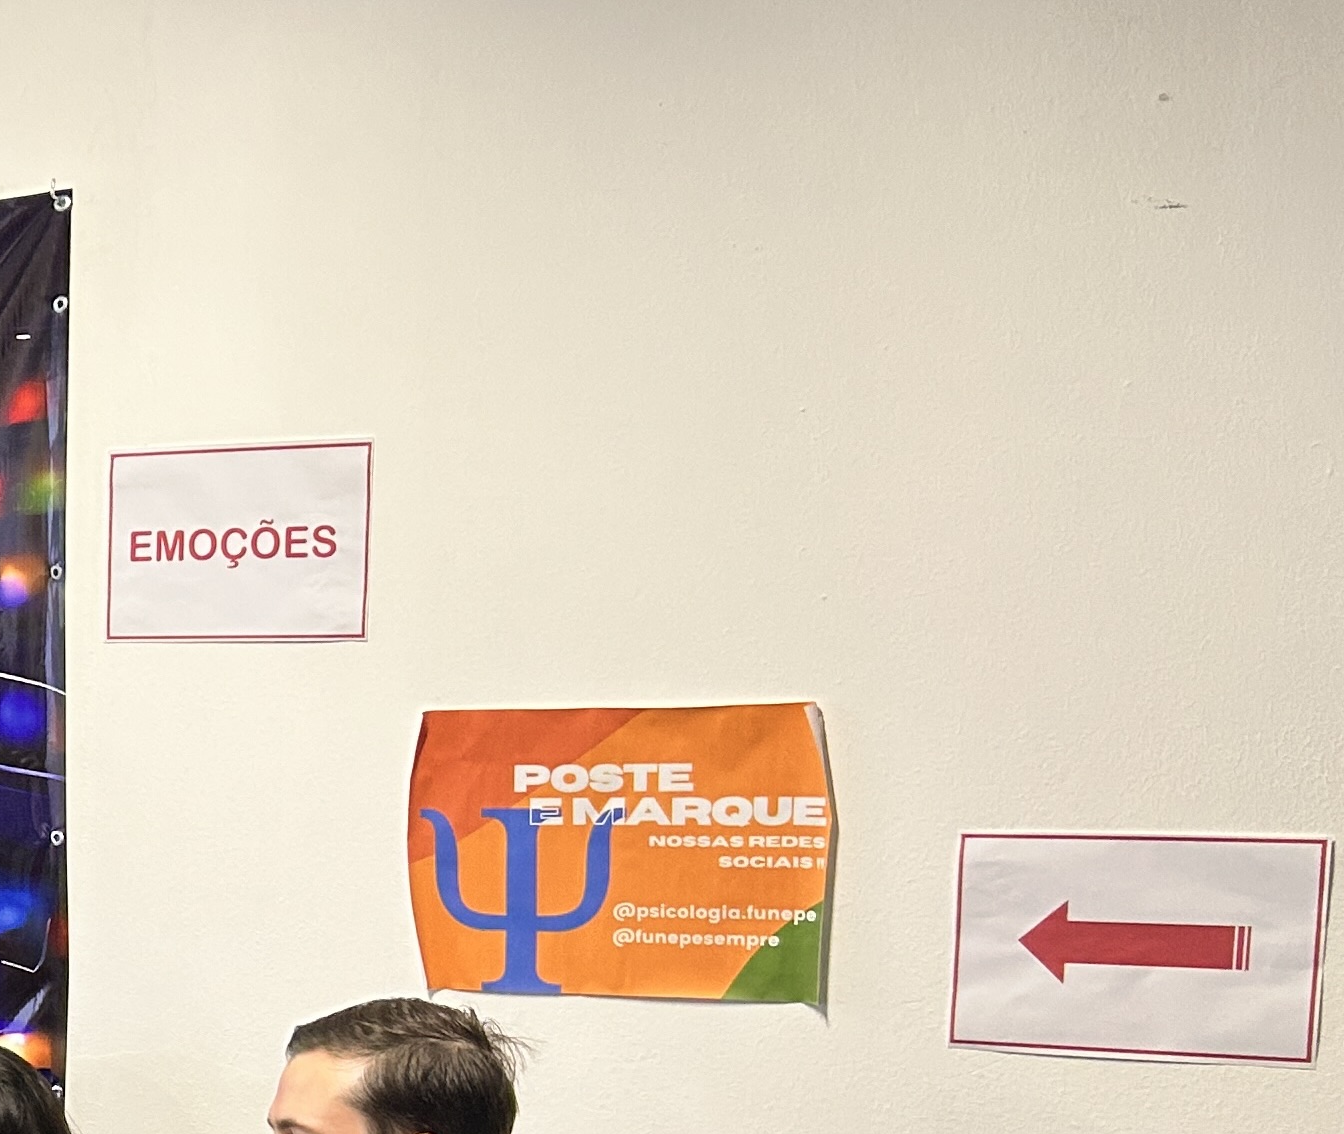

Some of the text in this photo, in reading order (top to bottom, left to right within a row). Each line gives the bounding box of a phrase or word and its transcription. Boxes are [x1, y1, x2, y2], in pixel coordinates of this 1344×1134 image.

[129, 518, 338, 569] EMOÇÕES
[513, 762, 694, 793] POSTE
[529, 796, 827, 827] E MARQUE
[648, 835, 826, 849] NOSSAS REDES
[718, 855, 813, 869] SOCIAIS
[612, 902, 817, 926] @psicologia.funepe
[612, 928, 780, 950] @funepesempre
